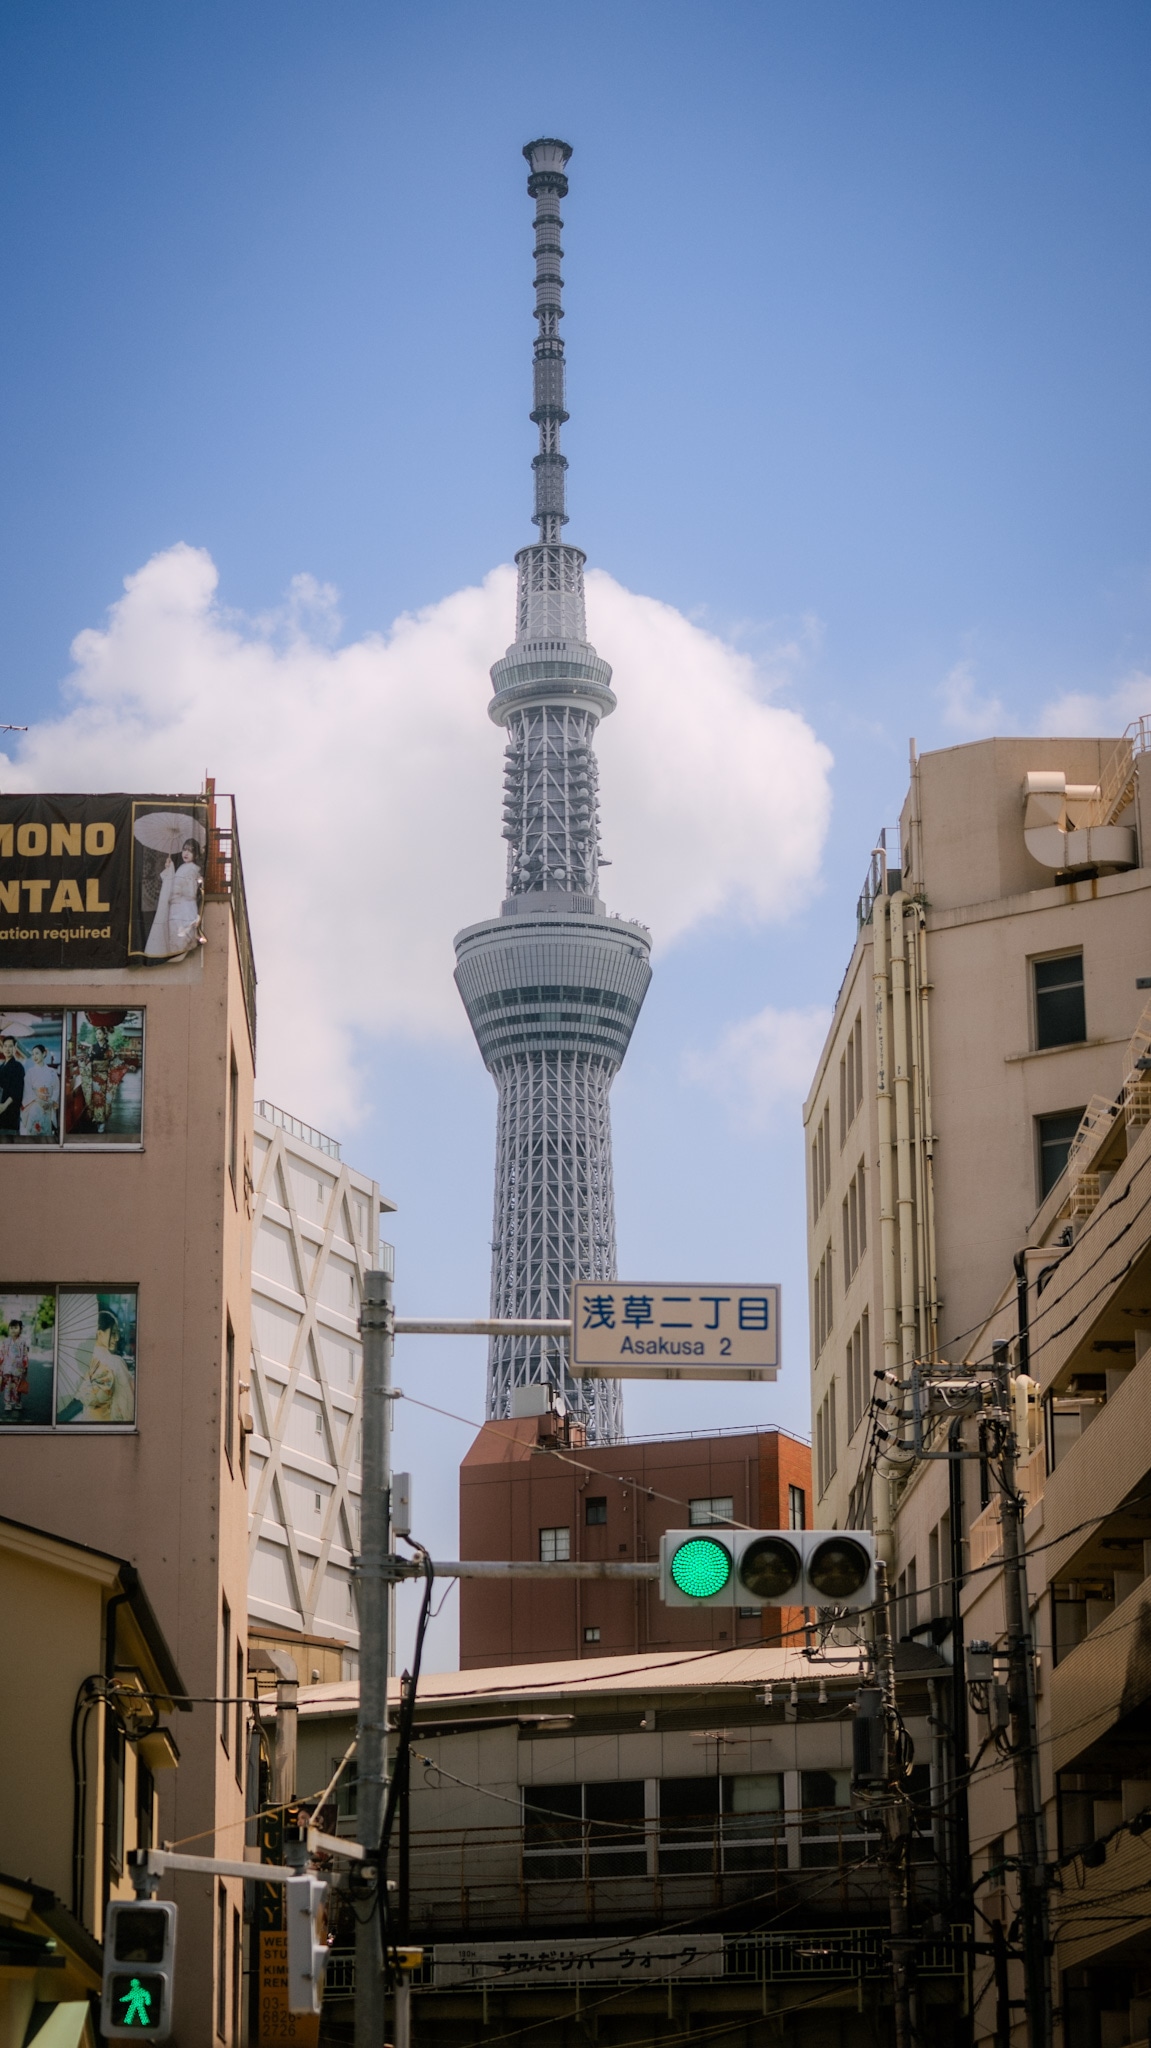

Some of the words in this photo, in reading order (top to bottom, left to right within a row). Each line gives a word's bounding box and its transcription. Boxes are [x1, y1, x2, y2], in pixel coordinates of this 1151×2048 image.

[43, 925, 111, 942] required
[582, 1294, 769, 1331] 浅草二丁目
[620, 1335, 705, 1355] Asakusa
[719, 1337, 732, 1356] 2
[264, 1965, 289, 1975] KIM
[263, 1997, 284, 2009] 03-
[263, 2024, 296, 2037] 2726
